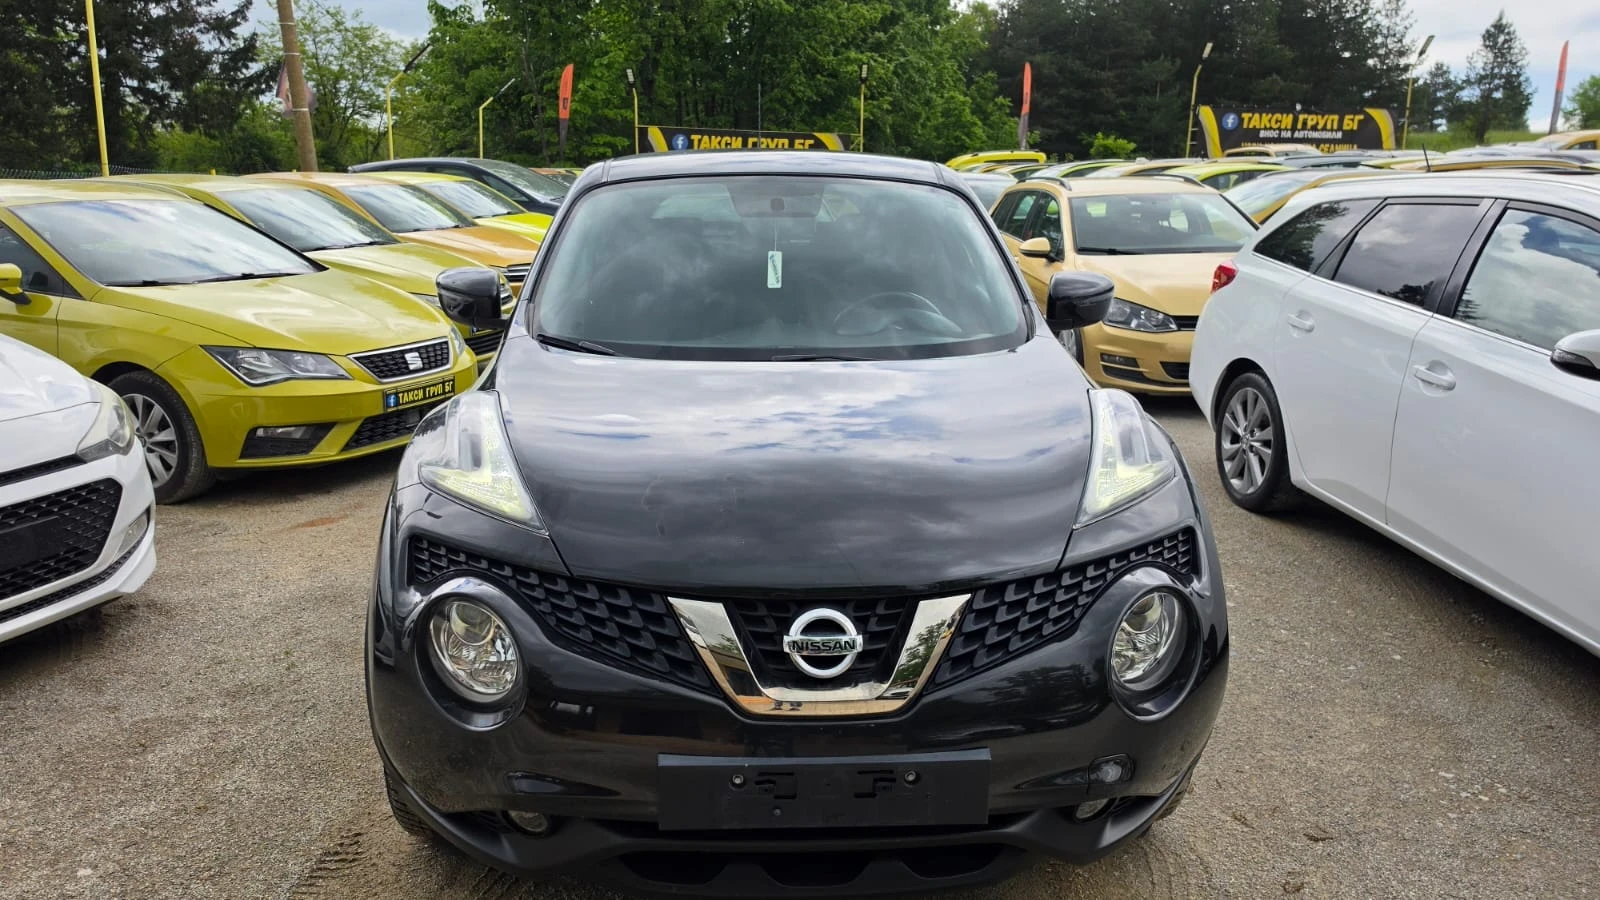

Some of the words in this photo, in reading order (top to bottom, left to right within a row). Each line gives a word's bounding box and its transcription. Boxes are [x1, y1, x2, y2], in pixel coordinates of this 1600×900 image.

[1241, 113, 1293, 129] ТАКСИ
[1297, 113, 1339, 130] ГРУП
[1343, 115, 1364, 130] БГ
[690, 134, 742, 150] ТАКСИ
[748, 137, 789, 150] ГРУП
[794, 139, 814, 150] БГ
[1259, 130, 1279, 138] ВНОС
[1280, 130, 1291, 139] НА
[1293, 130, 1343, 139] АВТОМОБИЛИ
[399, 389, 424, 404] ТАКСИ
[426, 384, 442, 398] ГРУП
[445, 381, 453, 392] БГ
[792, 640, 855, 651] NISSAN
